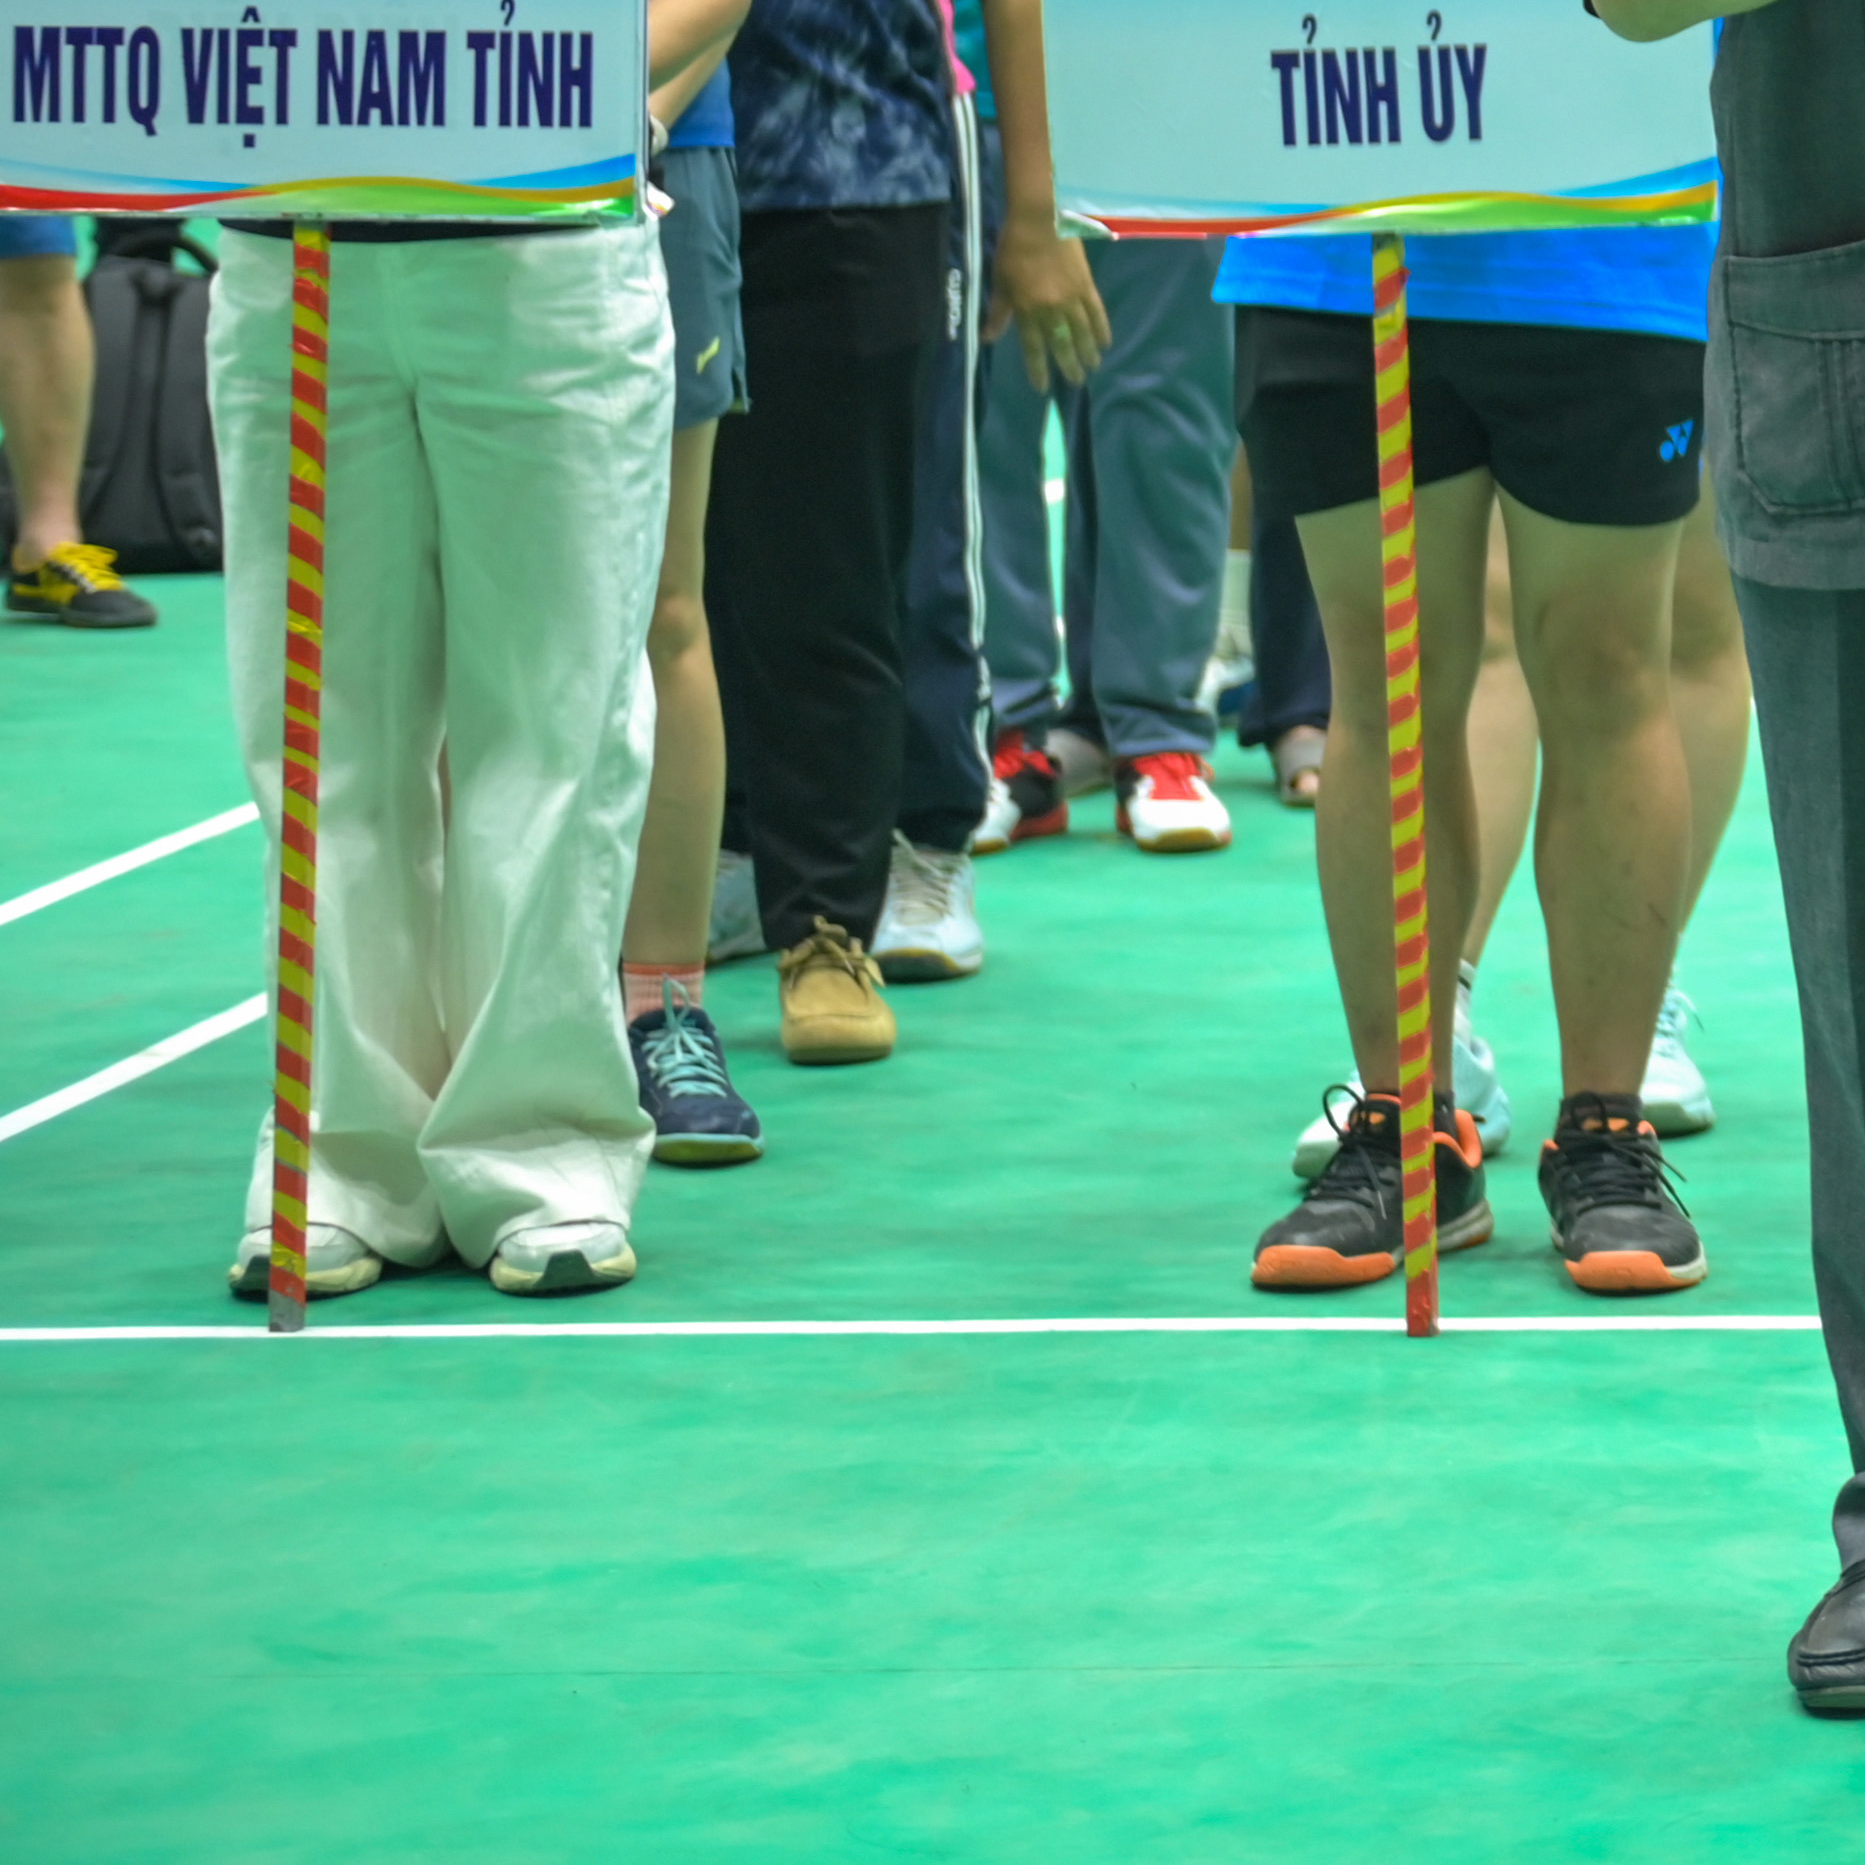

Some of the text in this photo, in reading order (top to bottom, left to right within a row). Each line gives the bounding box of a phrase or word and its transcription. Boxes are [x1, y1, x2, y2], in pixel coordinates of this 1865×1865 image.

[13, 25, 160, 136] MTTQ
[181, 6, 298, 148] VIỆT
[316, 29, 446, 126] NAM
[1270, 10, 1487, 146] TỈNH ỦY
